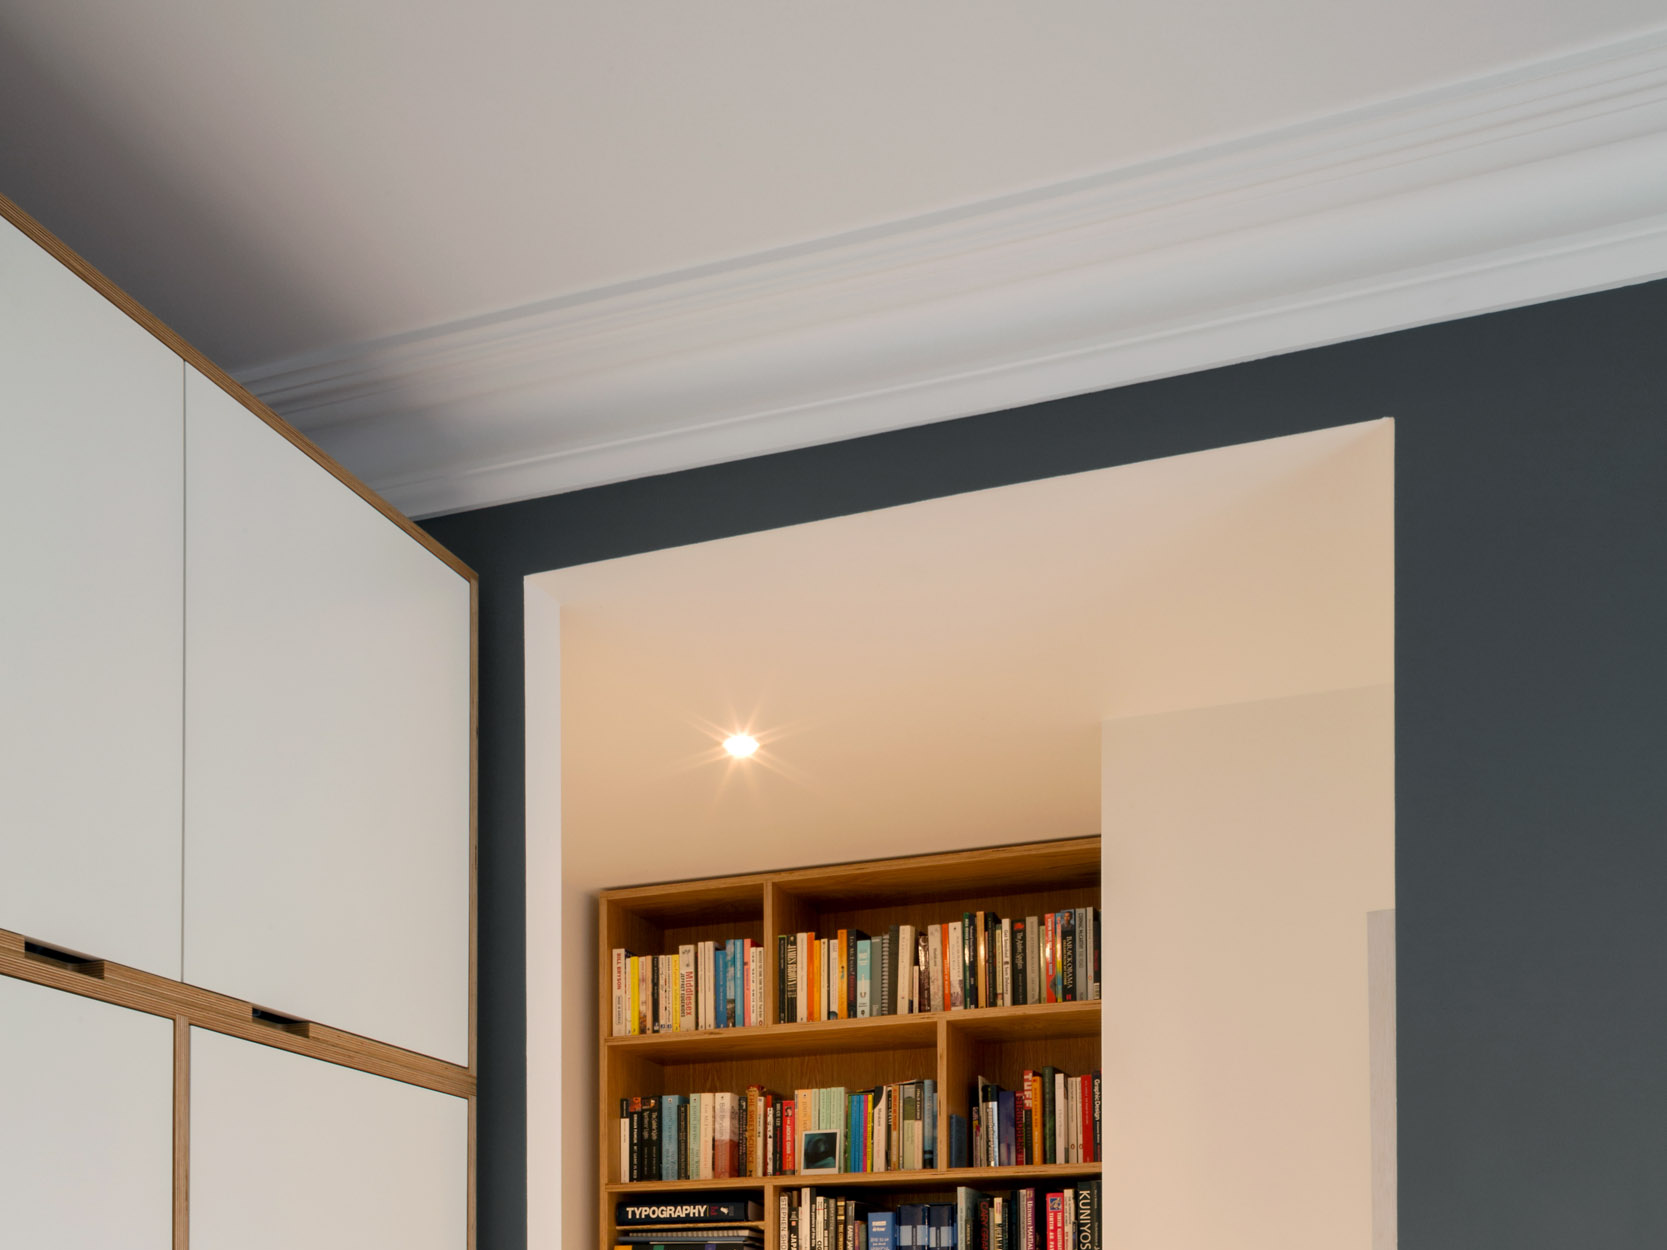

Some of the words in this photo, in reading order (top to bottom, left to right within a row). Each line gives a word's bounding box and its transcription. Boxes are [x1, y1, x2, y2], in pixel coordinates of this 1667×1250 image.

[685, 971, 694, 1016] Middlesex
[1023, 1072, 1033, 1108] TUFF
[626, 1205, 707, 1219] TYPOGRAPHY
[980, 1202, 989, 1225] CARY
